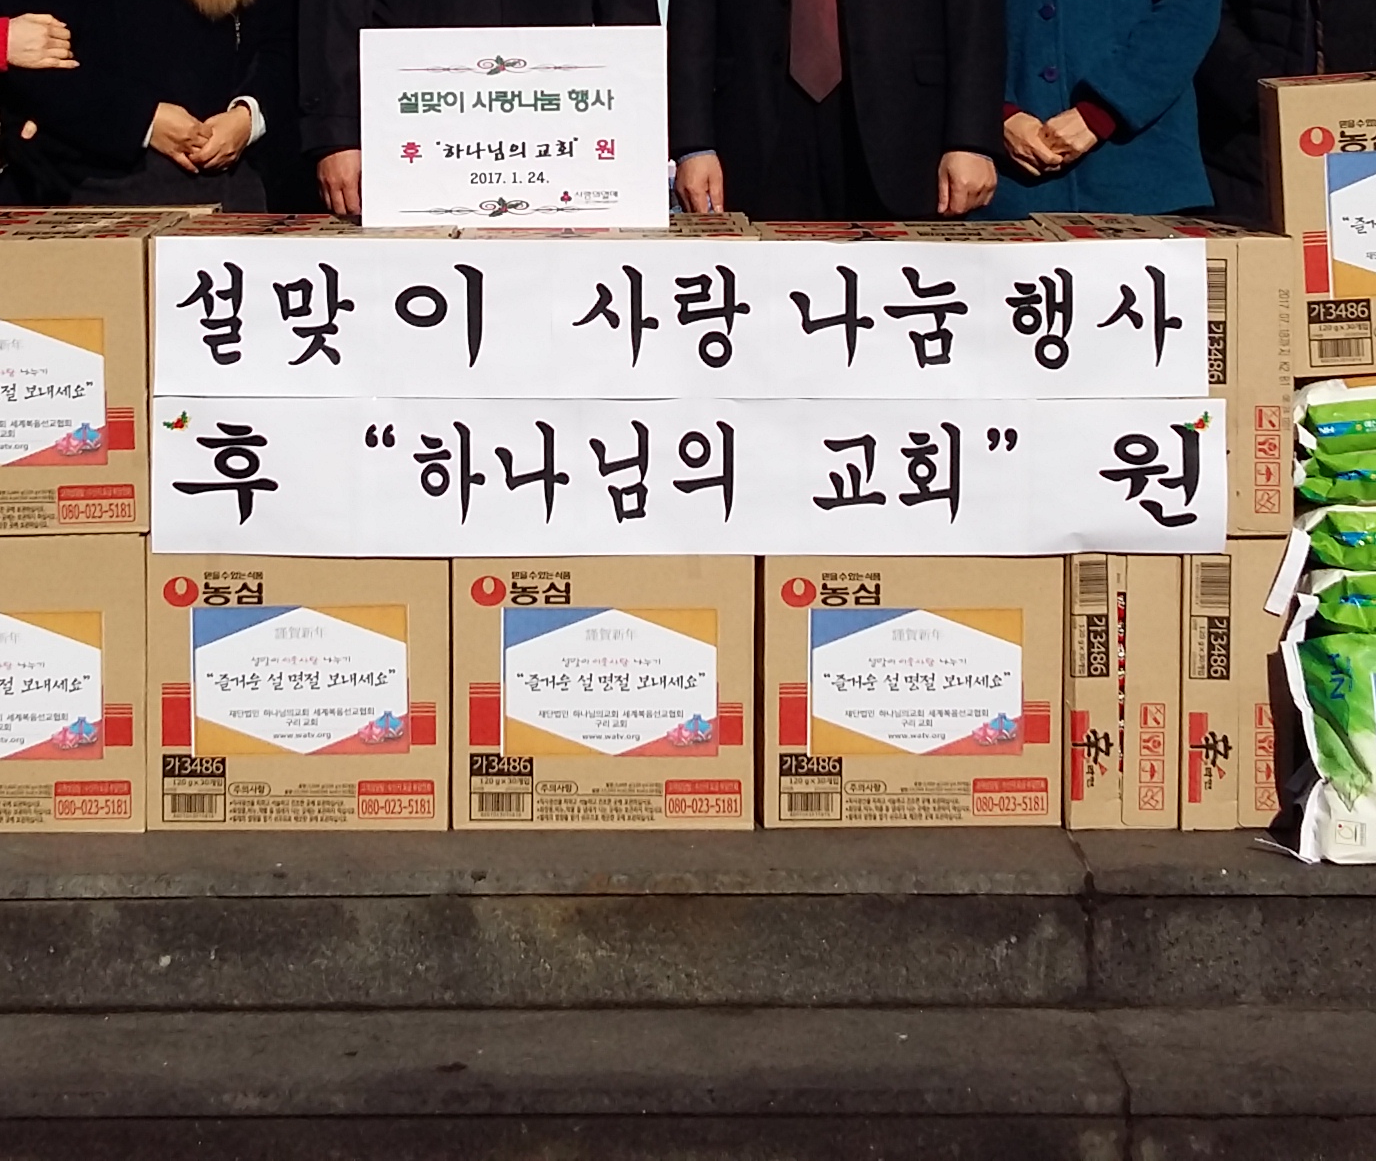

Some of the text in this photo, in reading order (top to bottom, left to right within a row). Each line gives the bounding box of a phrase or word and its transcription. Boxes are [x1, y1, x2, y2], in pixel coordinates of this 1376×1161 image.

[398, 89, 614, 114] 설맞이 사랑나눔 행사
[401, 142, 422, 163] 후
[595, 139, 615, 160] 원
[175, 261, 486, 369] 설맞이
[1310, 302, 1368, 321] 가3486
[171, 422, 280, 528] 후
[1097, 422, 1200, 528] 원
[61, 502, 132, 520] 080-023-5181
[555, 571, 571, 580] 식품
[202, 581, 264, 606] 농심
[509, 581, 572, 606] 농심
[820, 582, 881, 606] 농심
[577, 673, 594, 692] 설
[598, 673, 630, 692] 명절
[539, 710, 569, 719] 재단법인
[595, 719, 627, 728] 구리 교회
[165, 757, 224, 774] 가3486
[473, 756, 531, 773] 가3486
[782, 756, 840, 773] 가3486
[57, 798, 129, 816] 080-023-5181
[361, 797, 431, 815] 080-023-5181
[668, 797, 739, 814] 080-023-5181
[976, 796, 1046, 812] 080-023-5181
